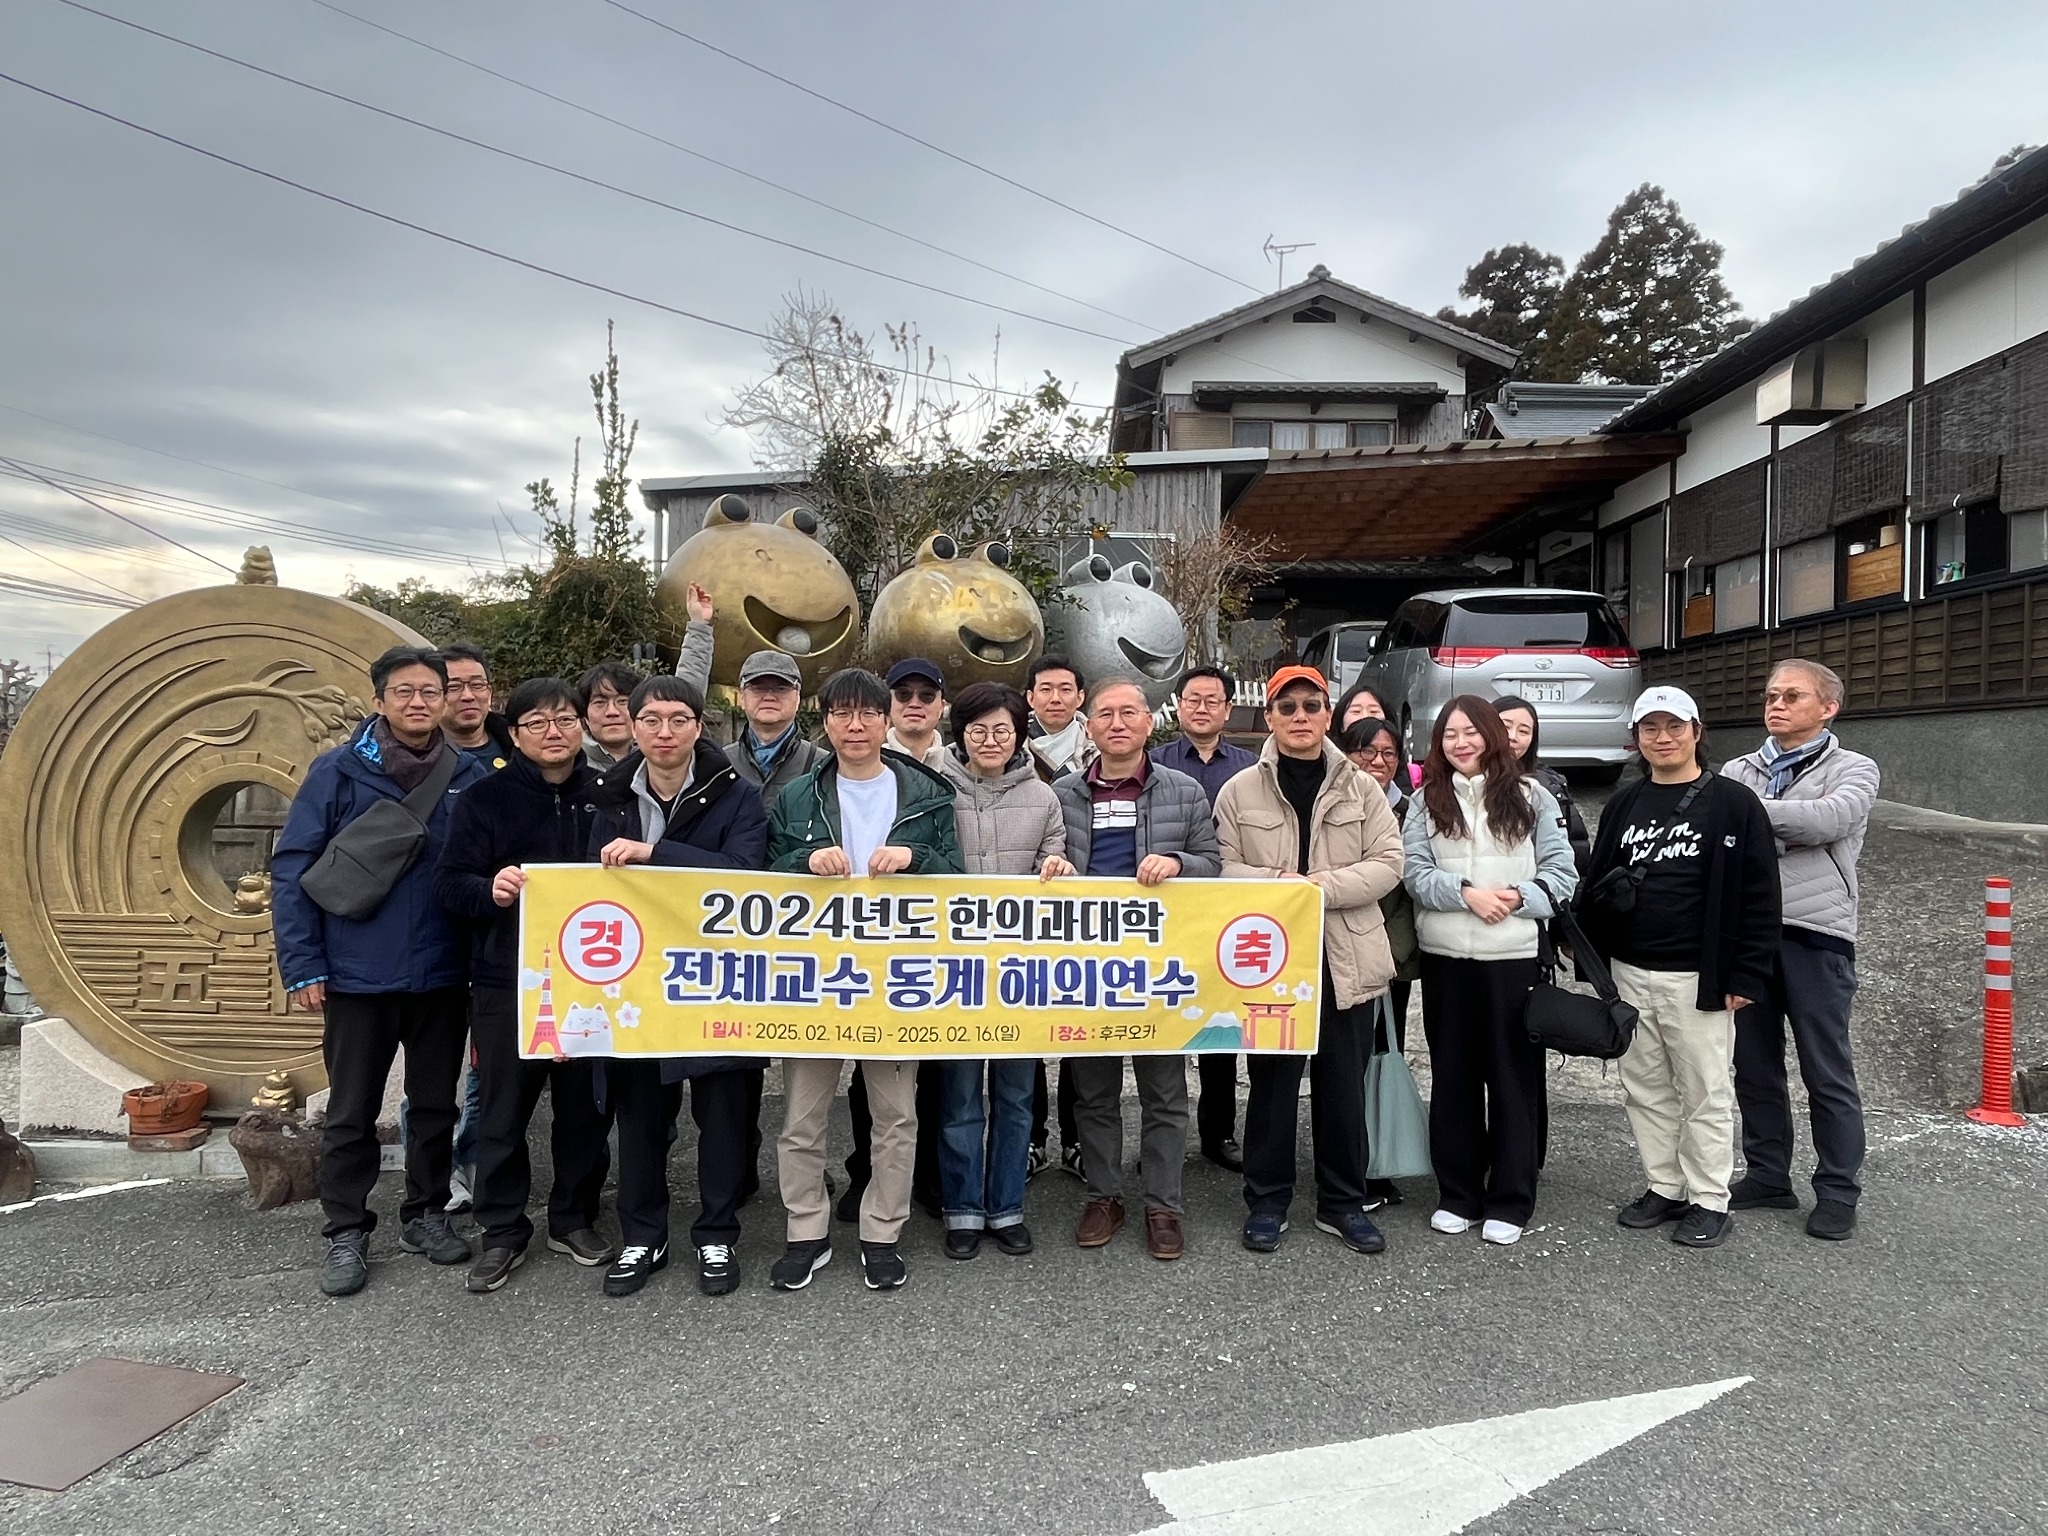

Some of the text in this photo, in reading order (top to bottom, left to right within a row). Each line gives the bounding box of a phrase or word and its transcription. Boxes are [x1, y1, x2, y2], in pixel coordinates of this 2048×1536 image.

[1620, 819, 1694, 848] Main
[702, 893, 1165, 943] 2024년도 한의과대학
[580, 920, 623, 968] 경
[1234, 929, 1272, 974] 축
[664, 951, 1196, 1008] 전체교수 동계 해외연수
[1099, 1024, 1157, 1041] 후쿠오카
